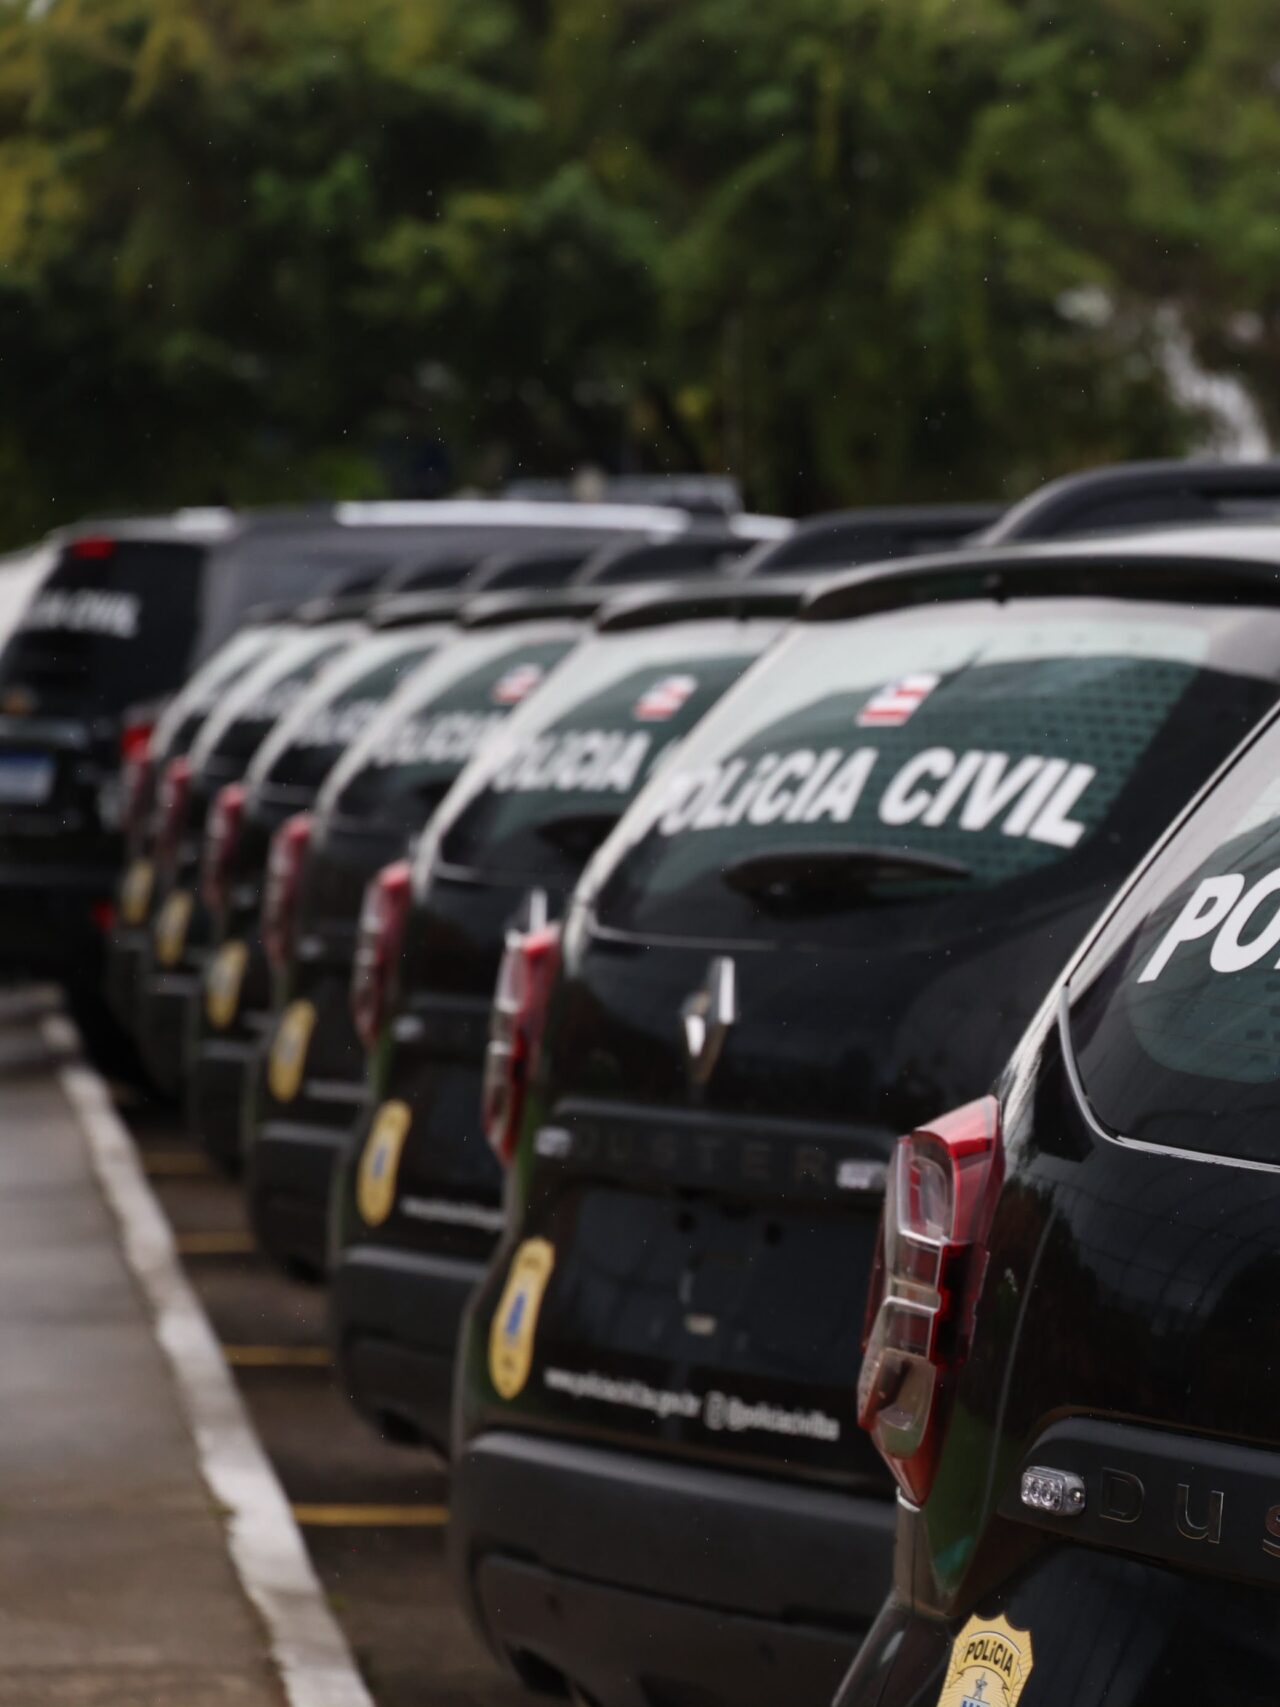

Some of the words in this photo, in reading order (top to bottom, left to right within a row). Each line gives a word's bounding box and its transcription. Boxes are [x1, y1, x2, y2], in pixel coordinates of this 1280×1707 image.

[640, 747, 880, 842] OLÍCIA
[877, 747, 1097, 849] CIVIL
[963, 1639, 1014, 1678] POLÍCIA
